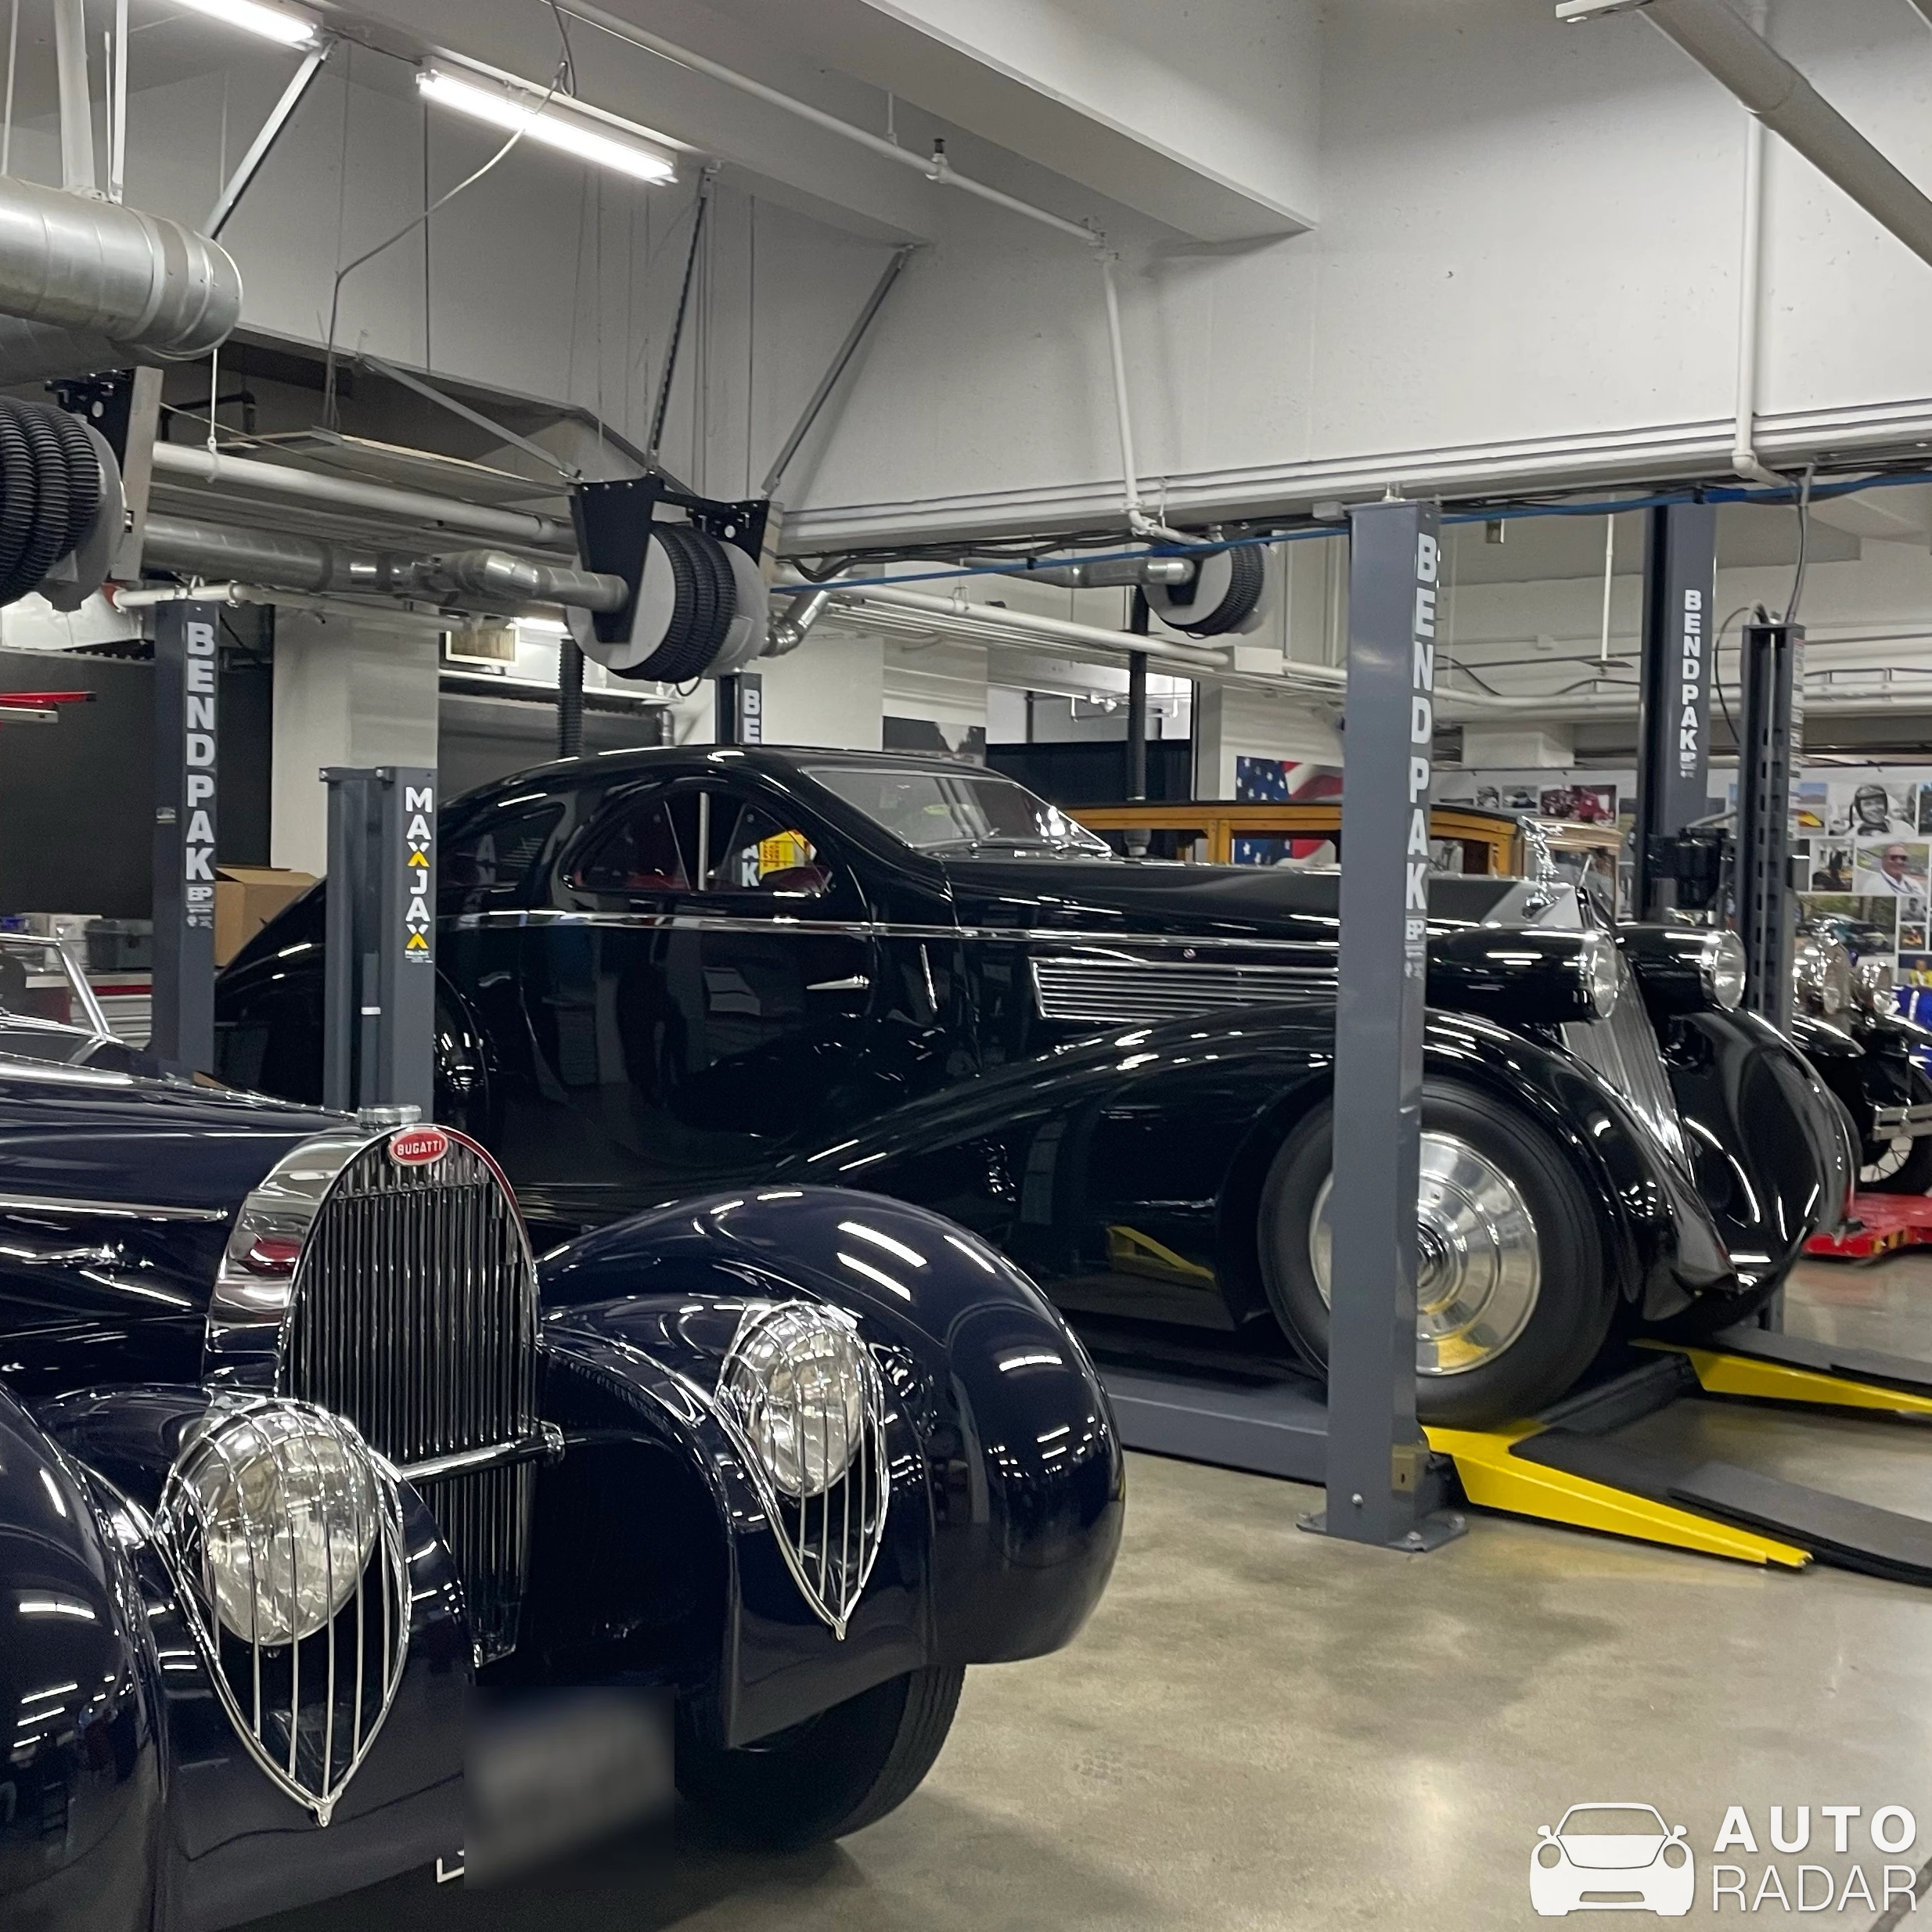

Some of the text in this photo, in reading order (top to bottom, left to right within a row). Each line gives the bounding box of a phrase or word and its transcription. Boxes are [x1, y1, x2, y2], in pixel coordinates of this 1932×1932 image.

[186, 621, 215, 880] BENDPAK
[1405, 532, 1437, 910] BENDPAK
[1679, 589, 1702, 750] BENDPAK
[405, 786, 433, 949] MAXJAX
[397, 1140, 442, 1156] BUGATTI
